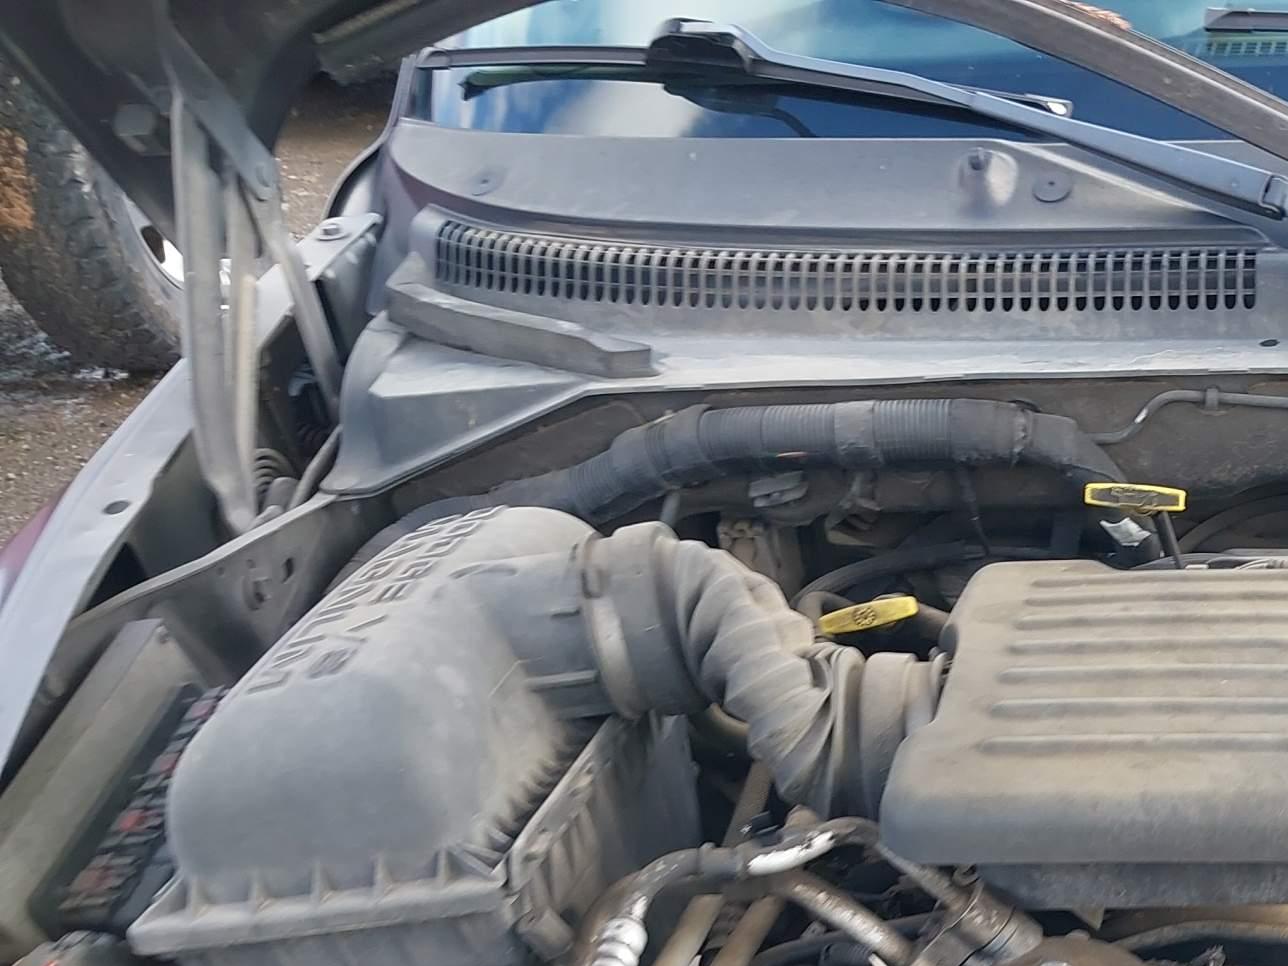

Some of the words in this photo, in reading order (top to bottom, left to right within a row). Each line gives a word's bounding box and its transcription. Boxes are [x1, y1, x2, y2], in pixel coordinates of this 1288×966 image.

[245, 513, 463, 695] MAGNUM
[369, 504, 509, 605] DODGE
[307, 615, 389, 680] V8
